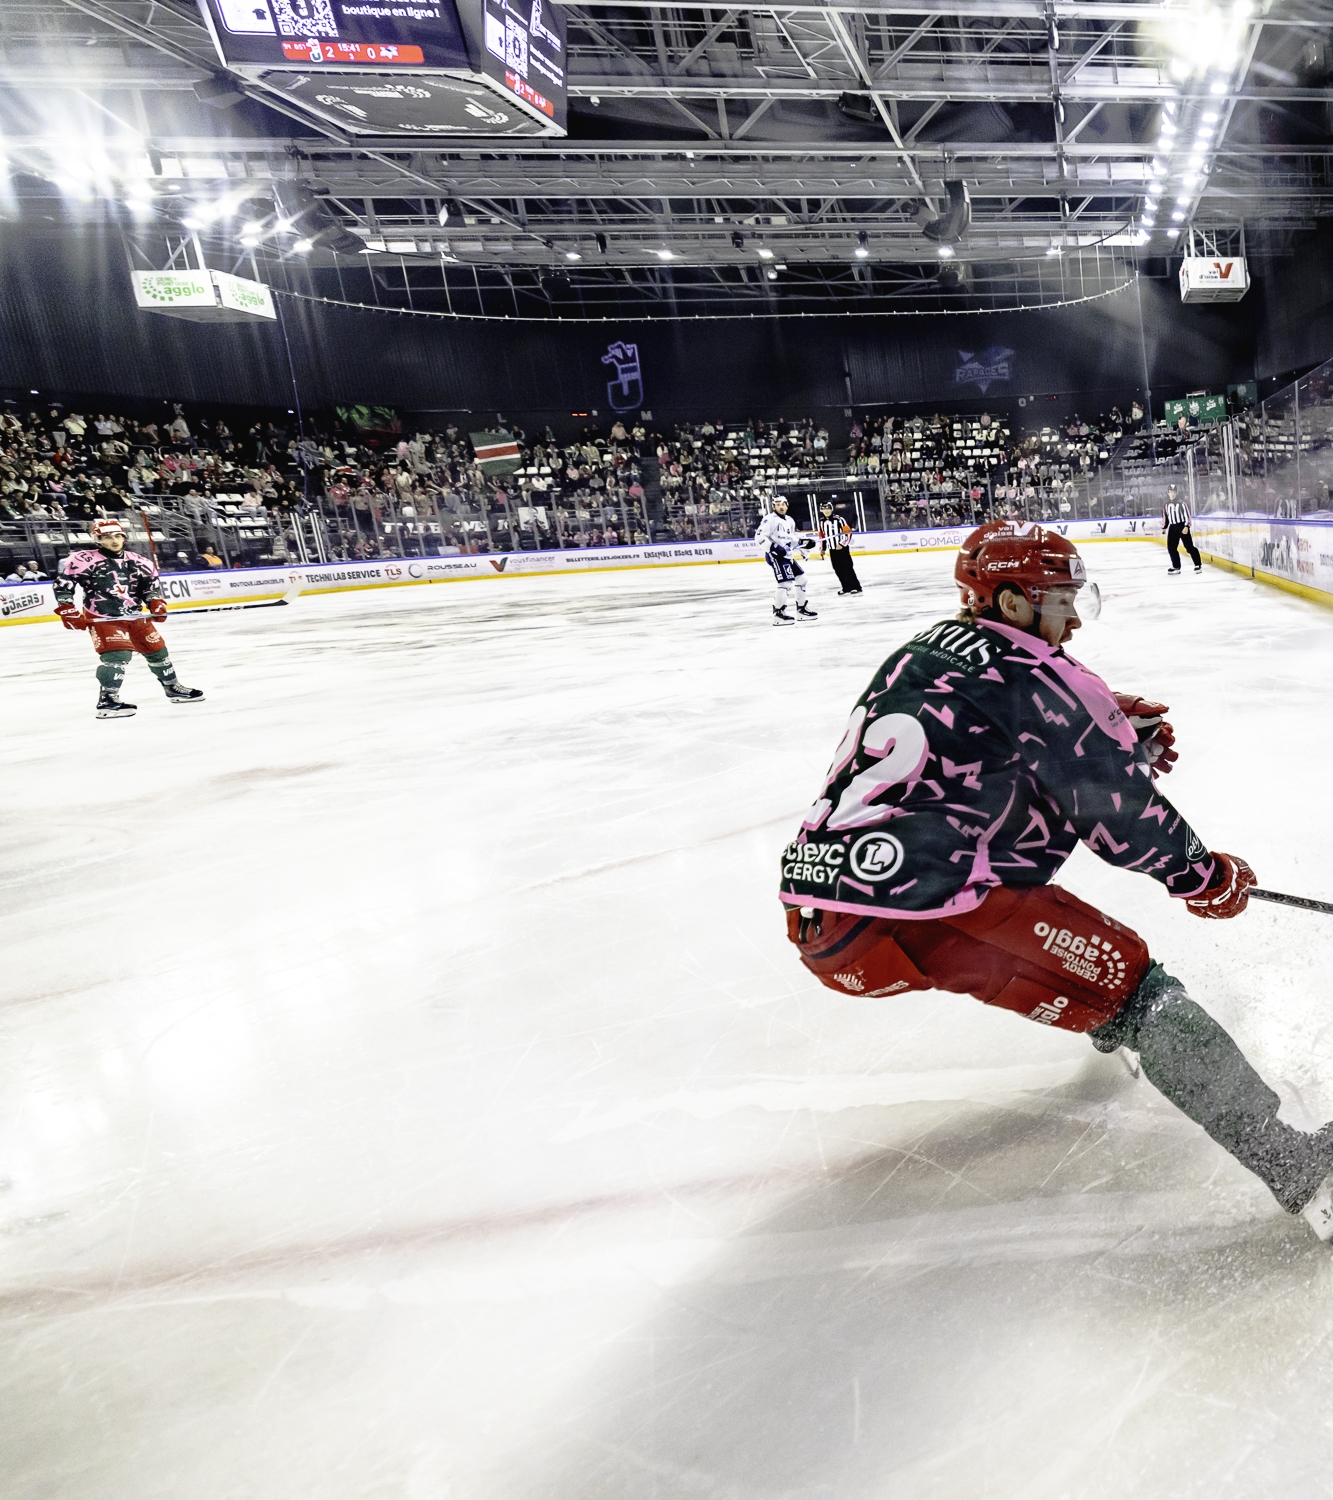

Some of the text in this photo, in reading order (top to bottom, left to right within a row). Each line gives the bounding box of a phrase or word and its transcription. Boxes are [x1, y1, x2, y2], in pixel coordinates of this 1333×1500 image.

[342, 5, 392, 18] boutique
[392, 8, 407, 17] en
[407, 7, 434, 19] ligne
[325, 43, 376, 59] 2 15:41 0
[164, 282, 205, 297] agglo
[240, 292, 265, 306] agglo
[983, 531, 1013, 539] d'oise
[643, 549, 673, 560] ENSEMBLE
[427, 562, 477, 571] ROUSSEAU
[987, 560, 1020, 570] CCM
[305, 573, 333, 584] TECHNI
[332, 572, 346, 581] LAB
[347, 569, 381, 580] SERVICE
[384, 568, 402, 577] TLS
[929, 649, 976, 673] MÉDICALE
[783, 862, 840, 885] CERGY
[1033, 921, 1100, 962] agglo
[1050, 945, 1102, 974] PONTOISE
